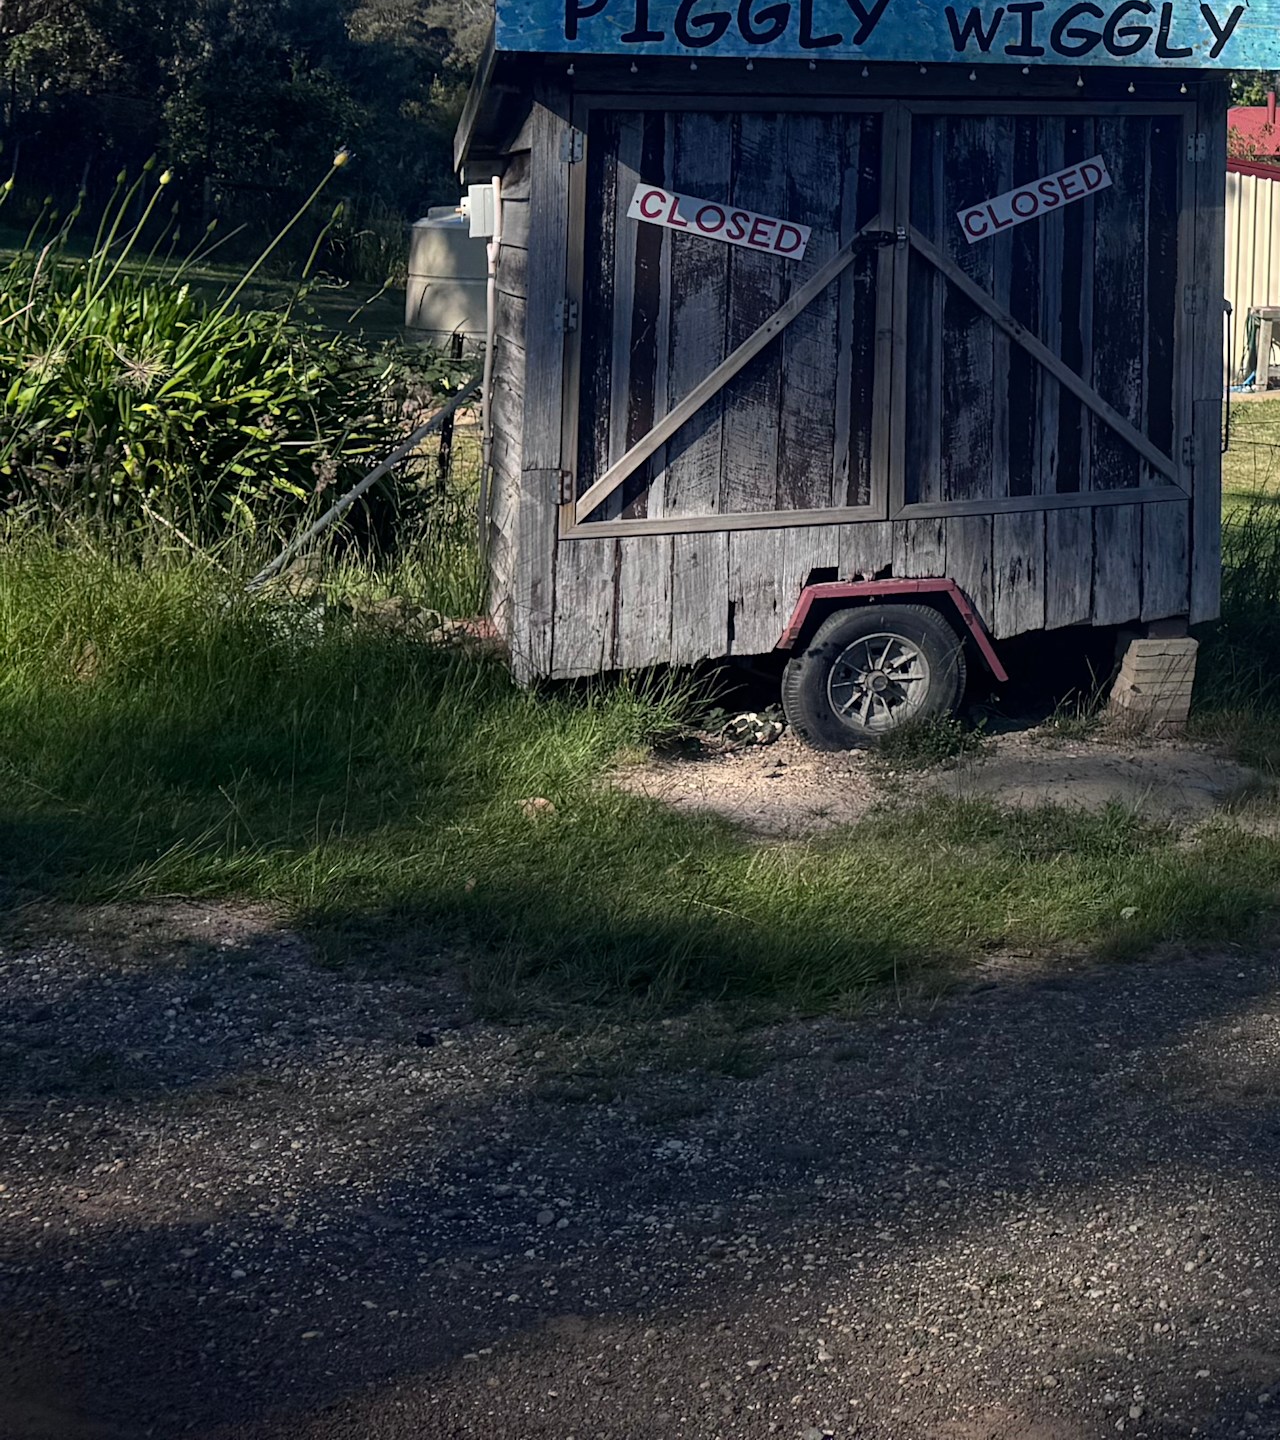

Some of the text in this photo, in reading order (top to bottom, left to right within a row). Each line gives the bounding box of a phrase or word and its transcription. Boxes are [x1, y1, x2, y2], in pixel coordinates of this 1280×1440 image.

[944, 0, 1245, 58] WIGGLY
[639, 190, 802, 254] CLOSED
[963, 163, 1103, 238] CLOSED
